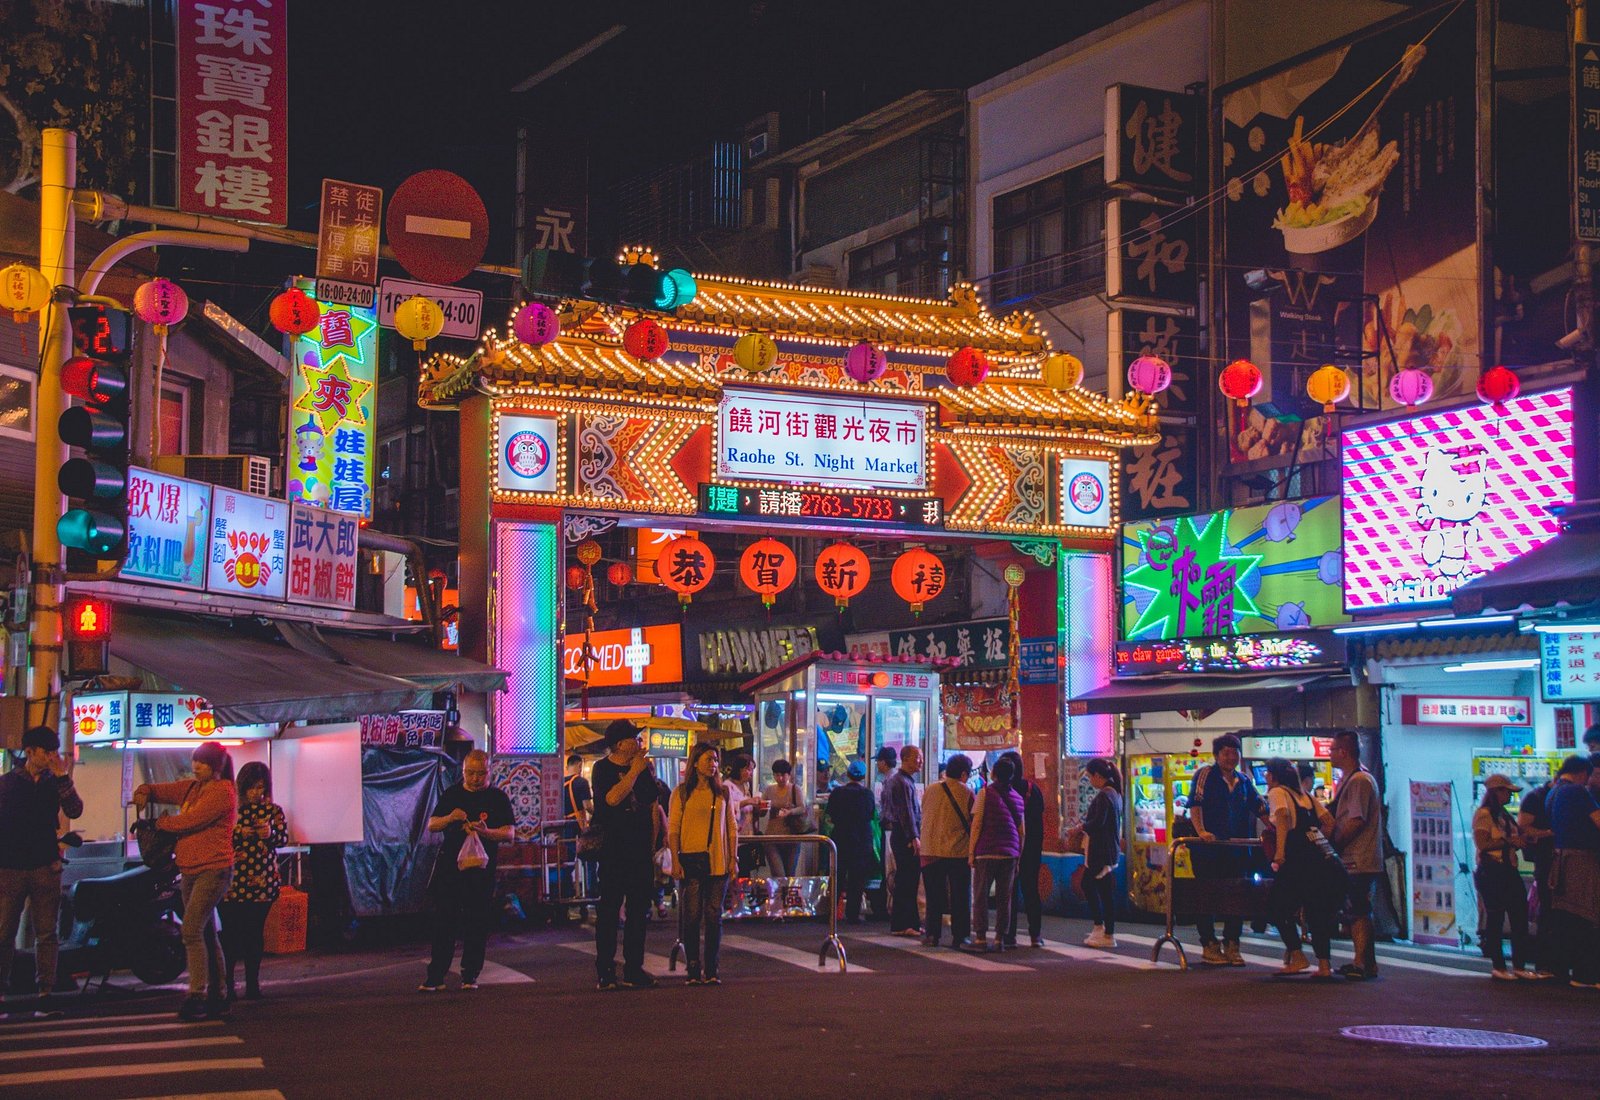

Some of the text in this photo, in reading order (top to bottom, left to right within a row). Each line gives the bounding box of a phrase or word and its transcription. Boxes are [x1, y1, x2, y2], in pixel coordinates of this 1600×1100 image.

[194, 0, 273, 215] 珠寶銀樓
[326, 186, 349, 273] 禁止停車
[352, 191, 374, 278] 徒步區內
[320, 282, 371, 304] 16:00-24:00
[728, 406, 918, 446] 饒河街觀光夜市
[333, 429, 365, 512] 娃娃屋
[727, 447, 919, 474] Raohe St. Night Market
[271, 529, 285, 574] 蟹肉
[292, 507, 355, 558] 武大郎
[291, 554, 355, 603] 胡椒餅
[670, 549, 706, 586] 恭
[752, 550, 785, 587] 賀
[821, 558, 857, 591] 新
[564, 643, 624, 675] COMED
[1133, 647, 1152, 661] claw
[1155, 647, 1181, 664] games
[1210, 643, 1226, 658] the
[402, 713, 442, 730] 不好吃
